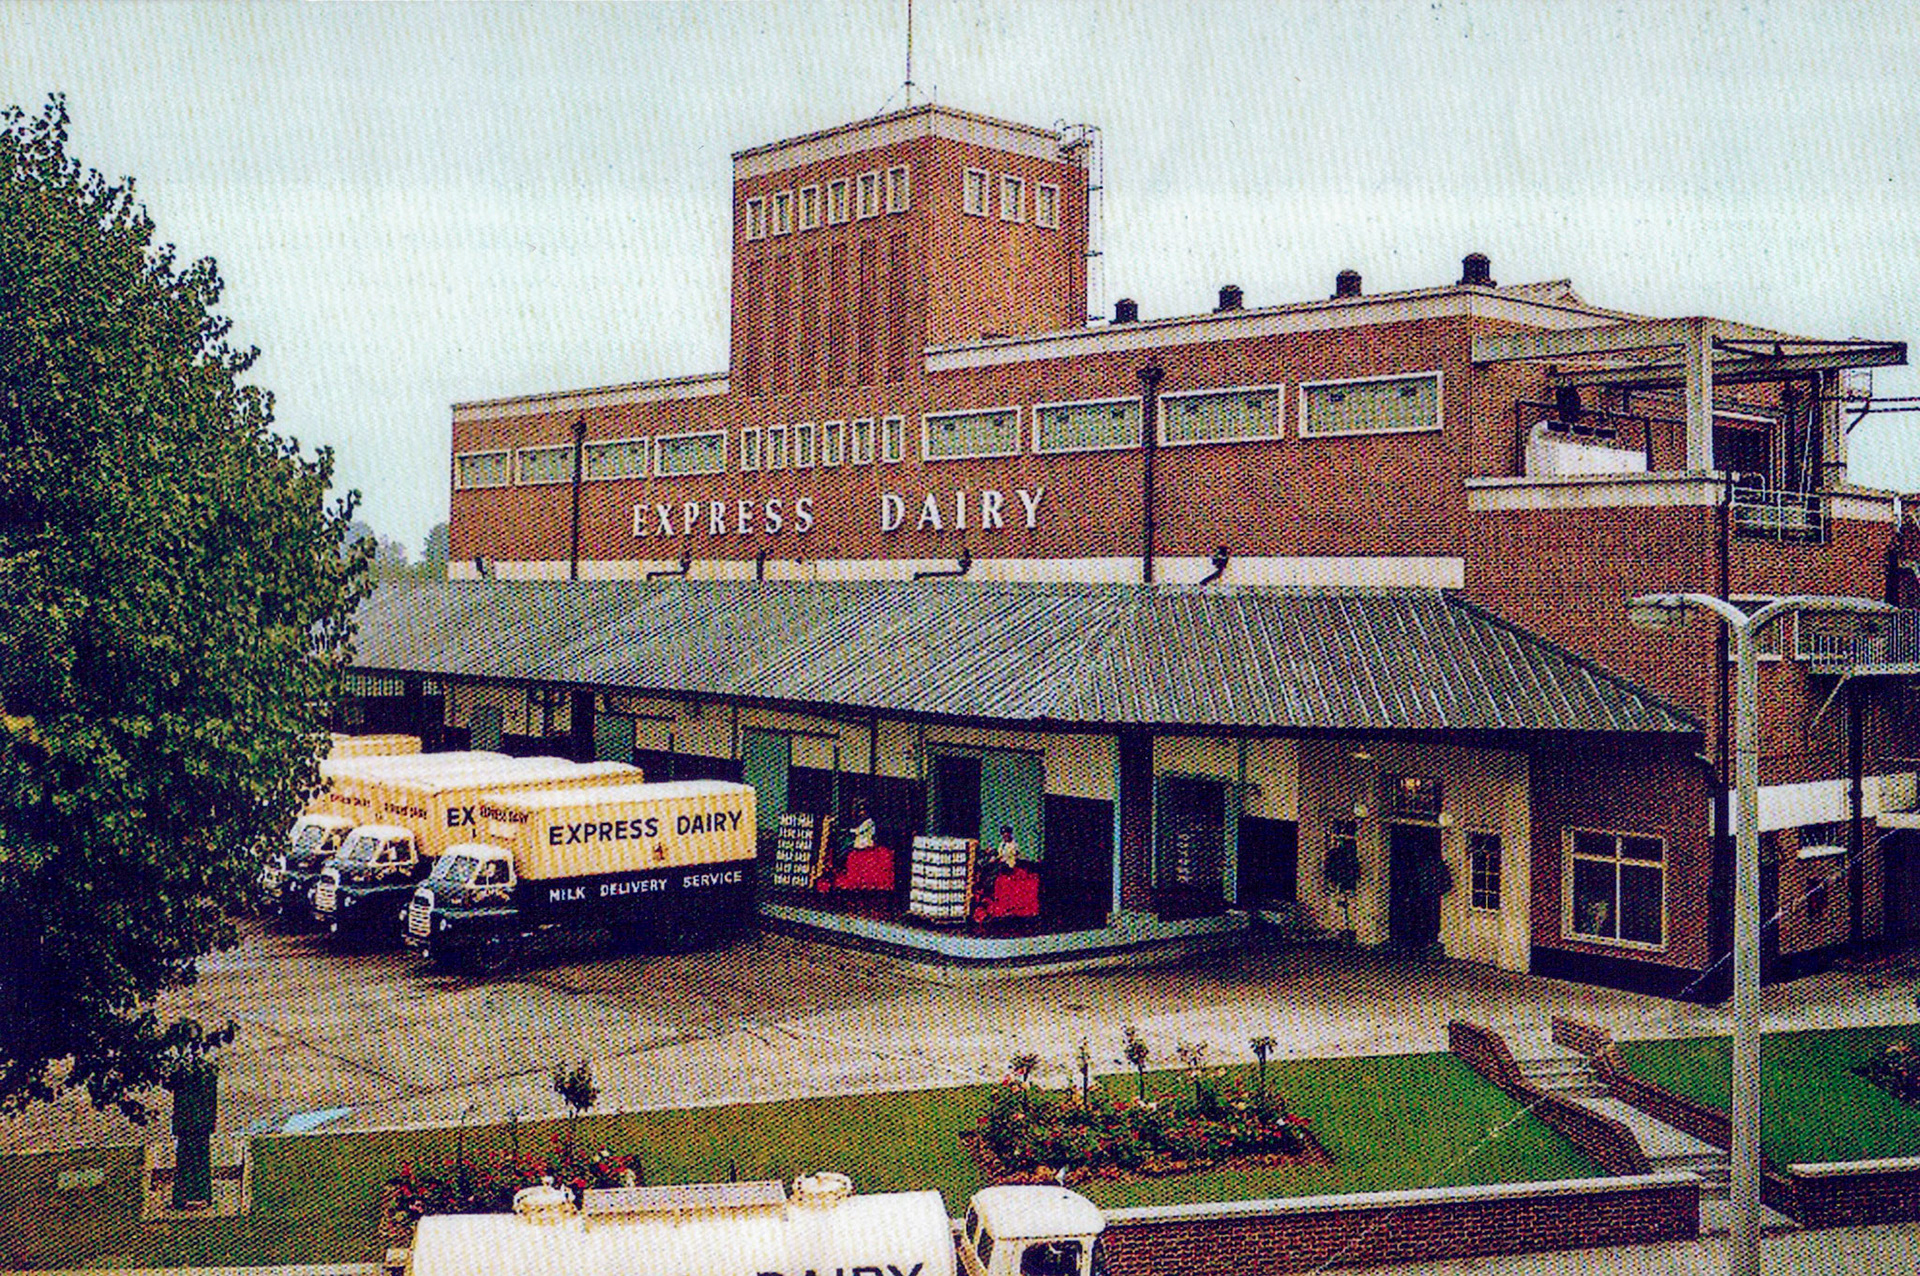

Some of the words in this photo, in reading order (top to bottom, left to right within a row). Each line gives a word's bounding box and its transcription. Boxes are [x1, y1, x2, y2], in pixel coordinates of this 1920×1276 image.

[632, 498, 815, 538] EXPRESS
[880, 487, 1045, 532] DAIRY
[549, 816, 660, 846] EXPRESS
[676, 809, 743, 836] DAIRY
[549, 885, 586, 903] MILK
[599, 878, 668, 898] DELIVERY
[682, 870, 743, 889] SERVICE
